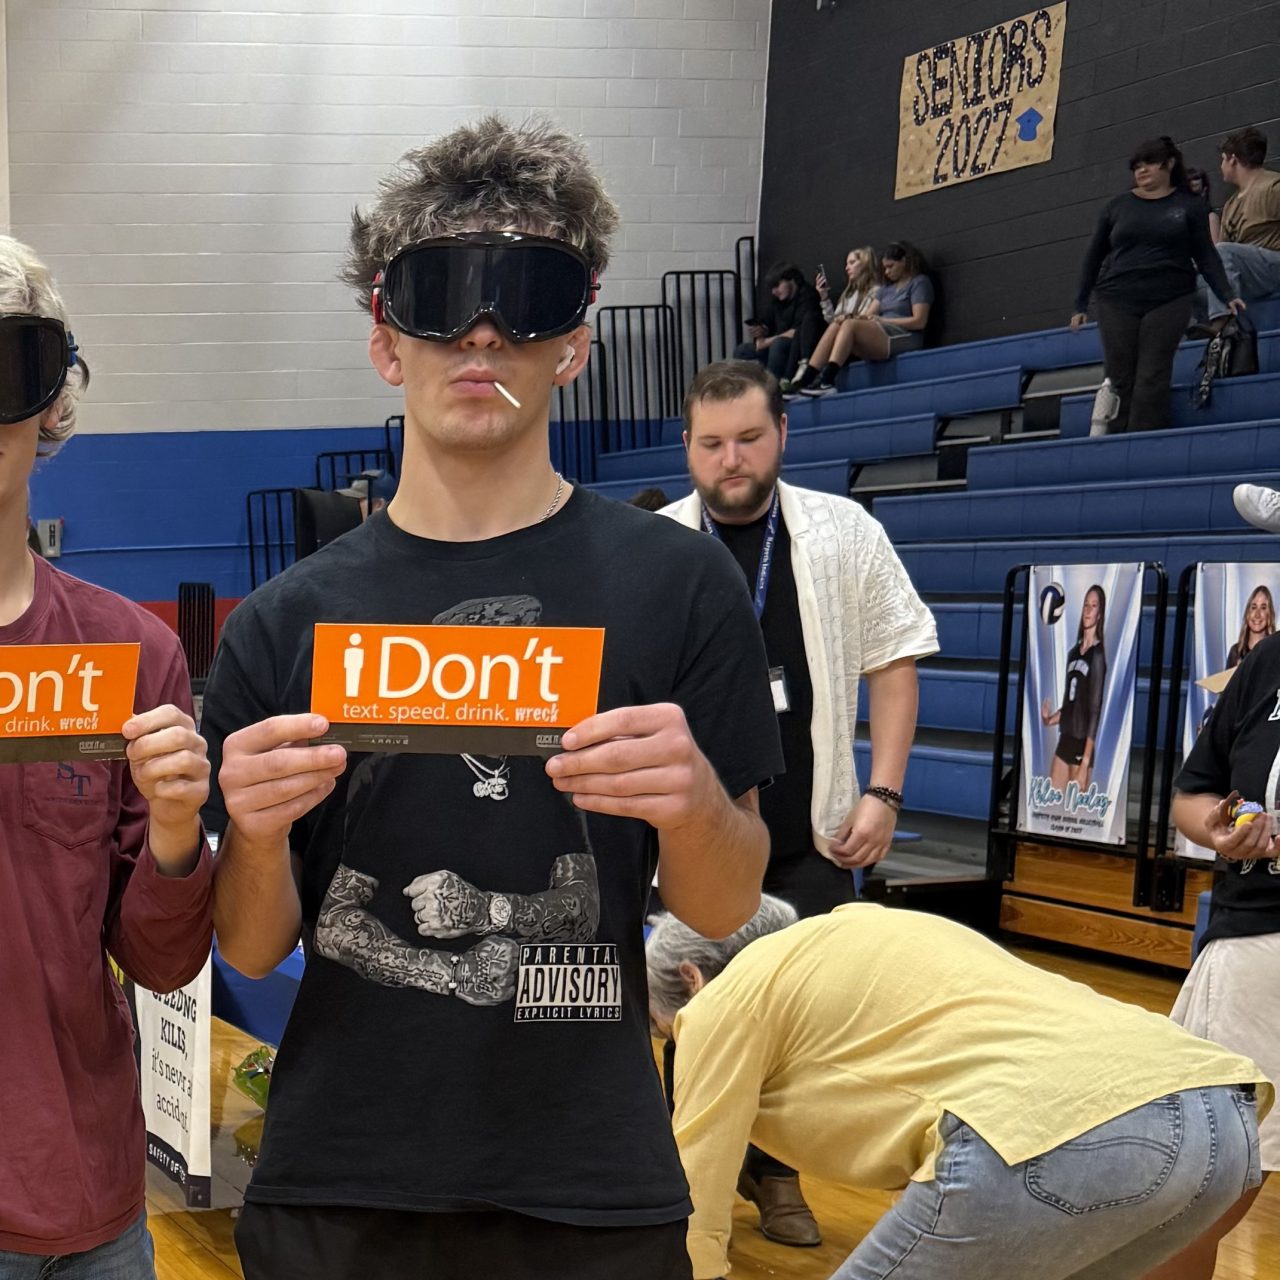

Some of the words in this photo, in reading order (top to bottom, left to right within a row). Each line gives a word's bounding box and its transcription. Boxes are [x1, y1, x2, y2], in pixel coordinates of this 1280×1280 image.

[913, 9, 1051, 127] SENIORS
[933, 98, 1014, 185] 2027
[5, 716, 55, 734] drink.
[59, 711, 99, 731] wreck
[342, 703, 383, 720] text.
[388, 703, 450, 724] speed.
[455, 703, 510, 722] drink.
[515, 702, 560, 723] wreck
[522, 946, 620, 965] PARENTAL
[519, 967, 619, 1004] ADVISORY
[517, 1008, 572, 1020] EXPLICIT
[579, 1007, 620, 1019] LYRICS
